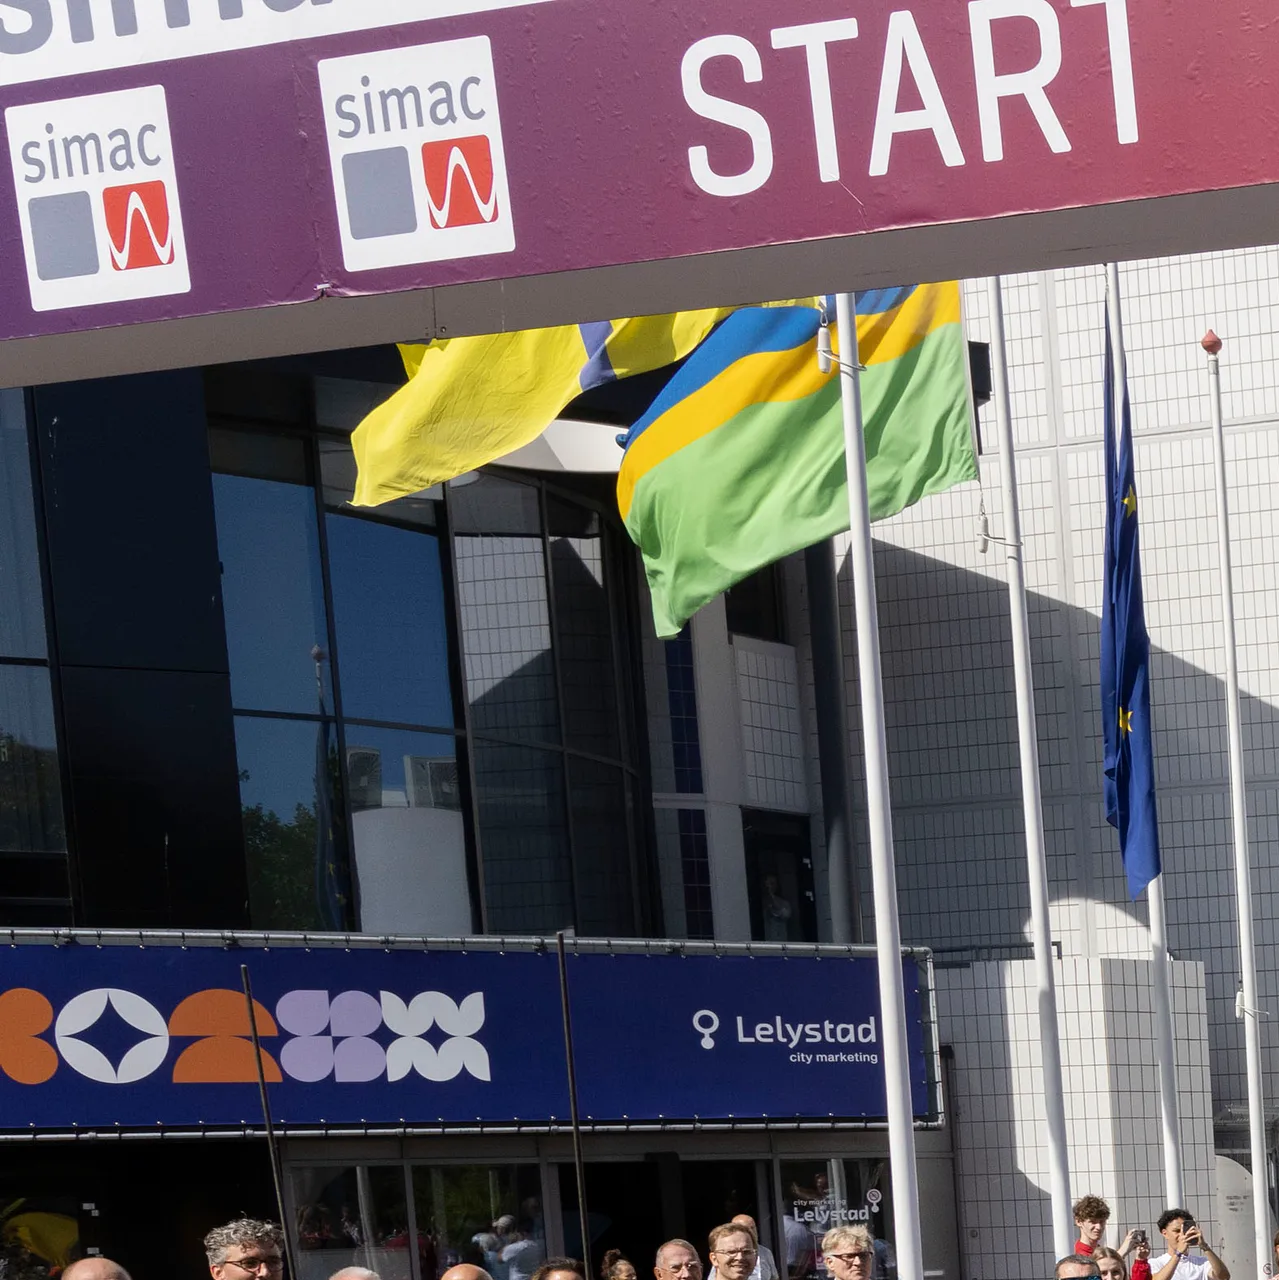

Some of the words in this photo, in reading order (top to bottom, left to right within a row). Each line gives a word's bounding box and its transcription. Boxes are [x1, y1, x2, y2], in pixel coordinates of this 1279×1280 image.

[335, 75, 487, 140] simac
[681, 0, 1138, 197] START
[21, 123, 162, 183] simac
[736, 1016, 877, 1049] Lelystad
[789, 1052, 813, 1065] city
[816, 1052, 879, 1065] marketing
[793, 1205, 870, 1224] Lelystad
